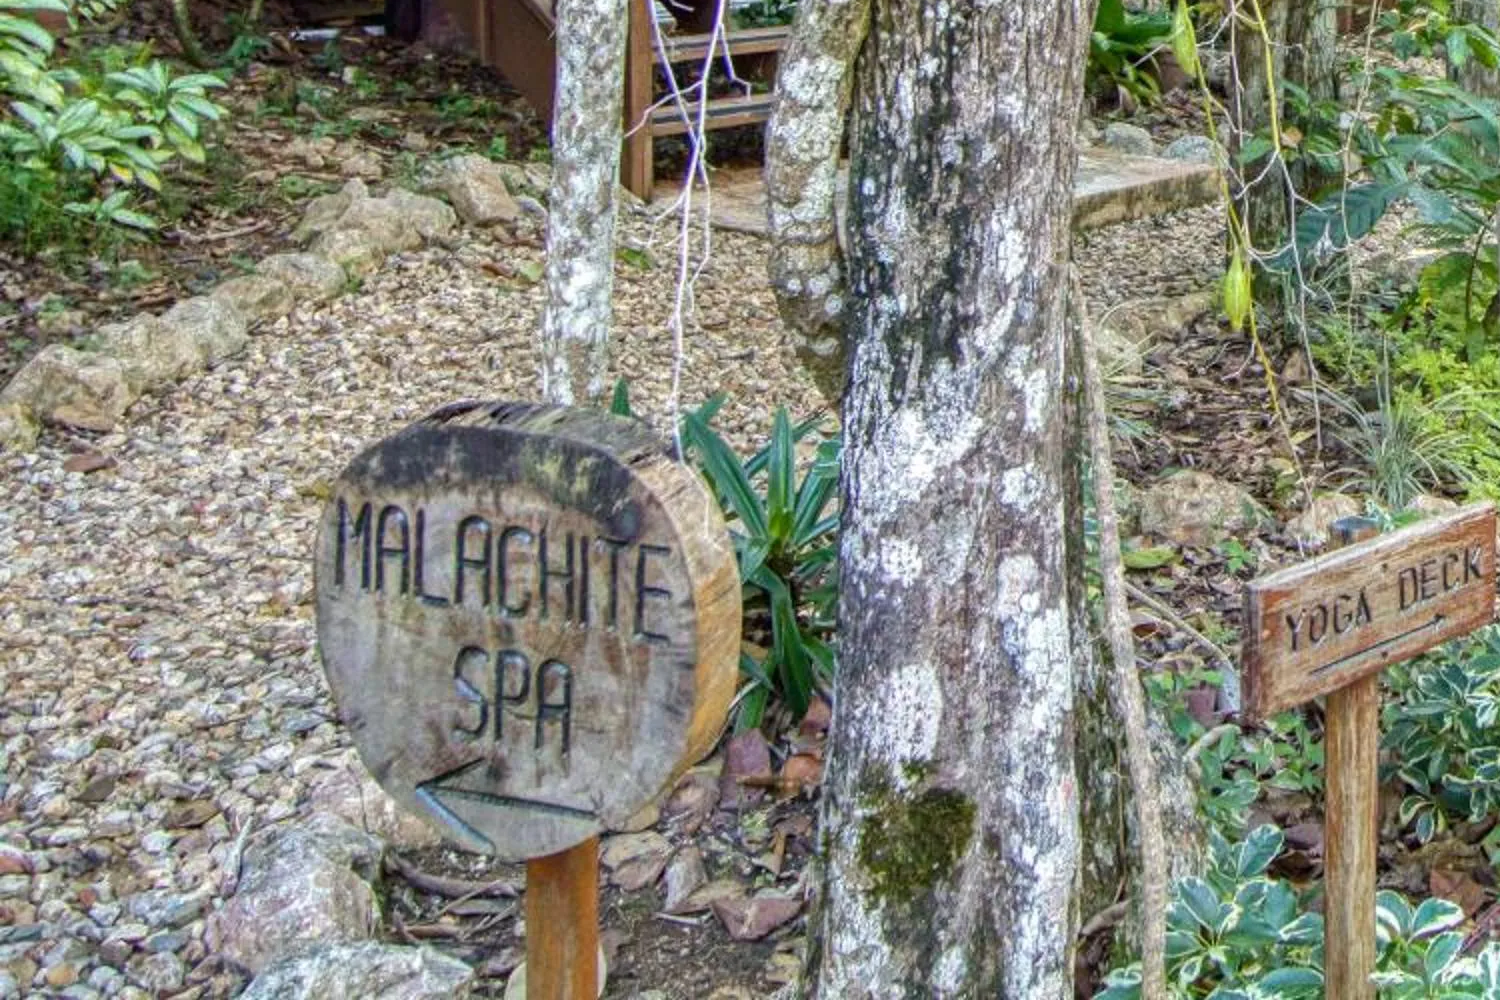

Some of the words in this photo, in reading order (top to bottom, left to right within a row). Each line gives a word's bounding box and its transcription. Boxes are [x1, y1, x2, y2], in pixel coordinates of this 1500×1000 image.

[333, 496, 672, 647] MALACHITE
[1285, 586, 1373, 651] YOGA
[1397, 538, 1483, 611] DECK
[452, 644, 572, 761] SPA
